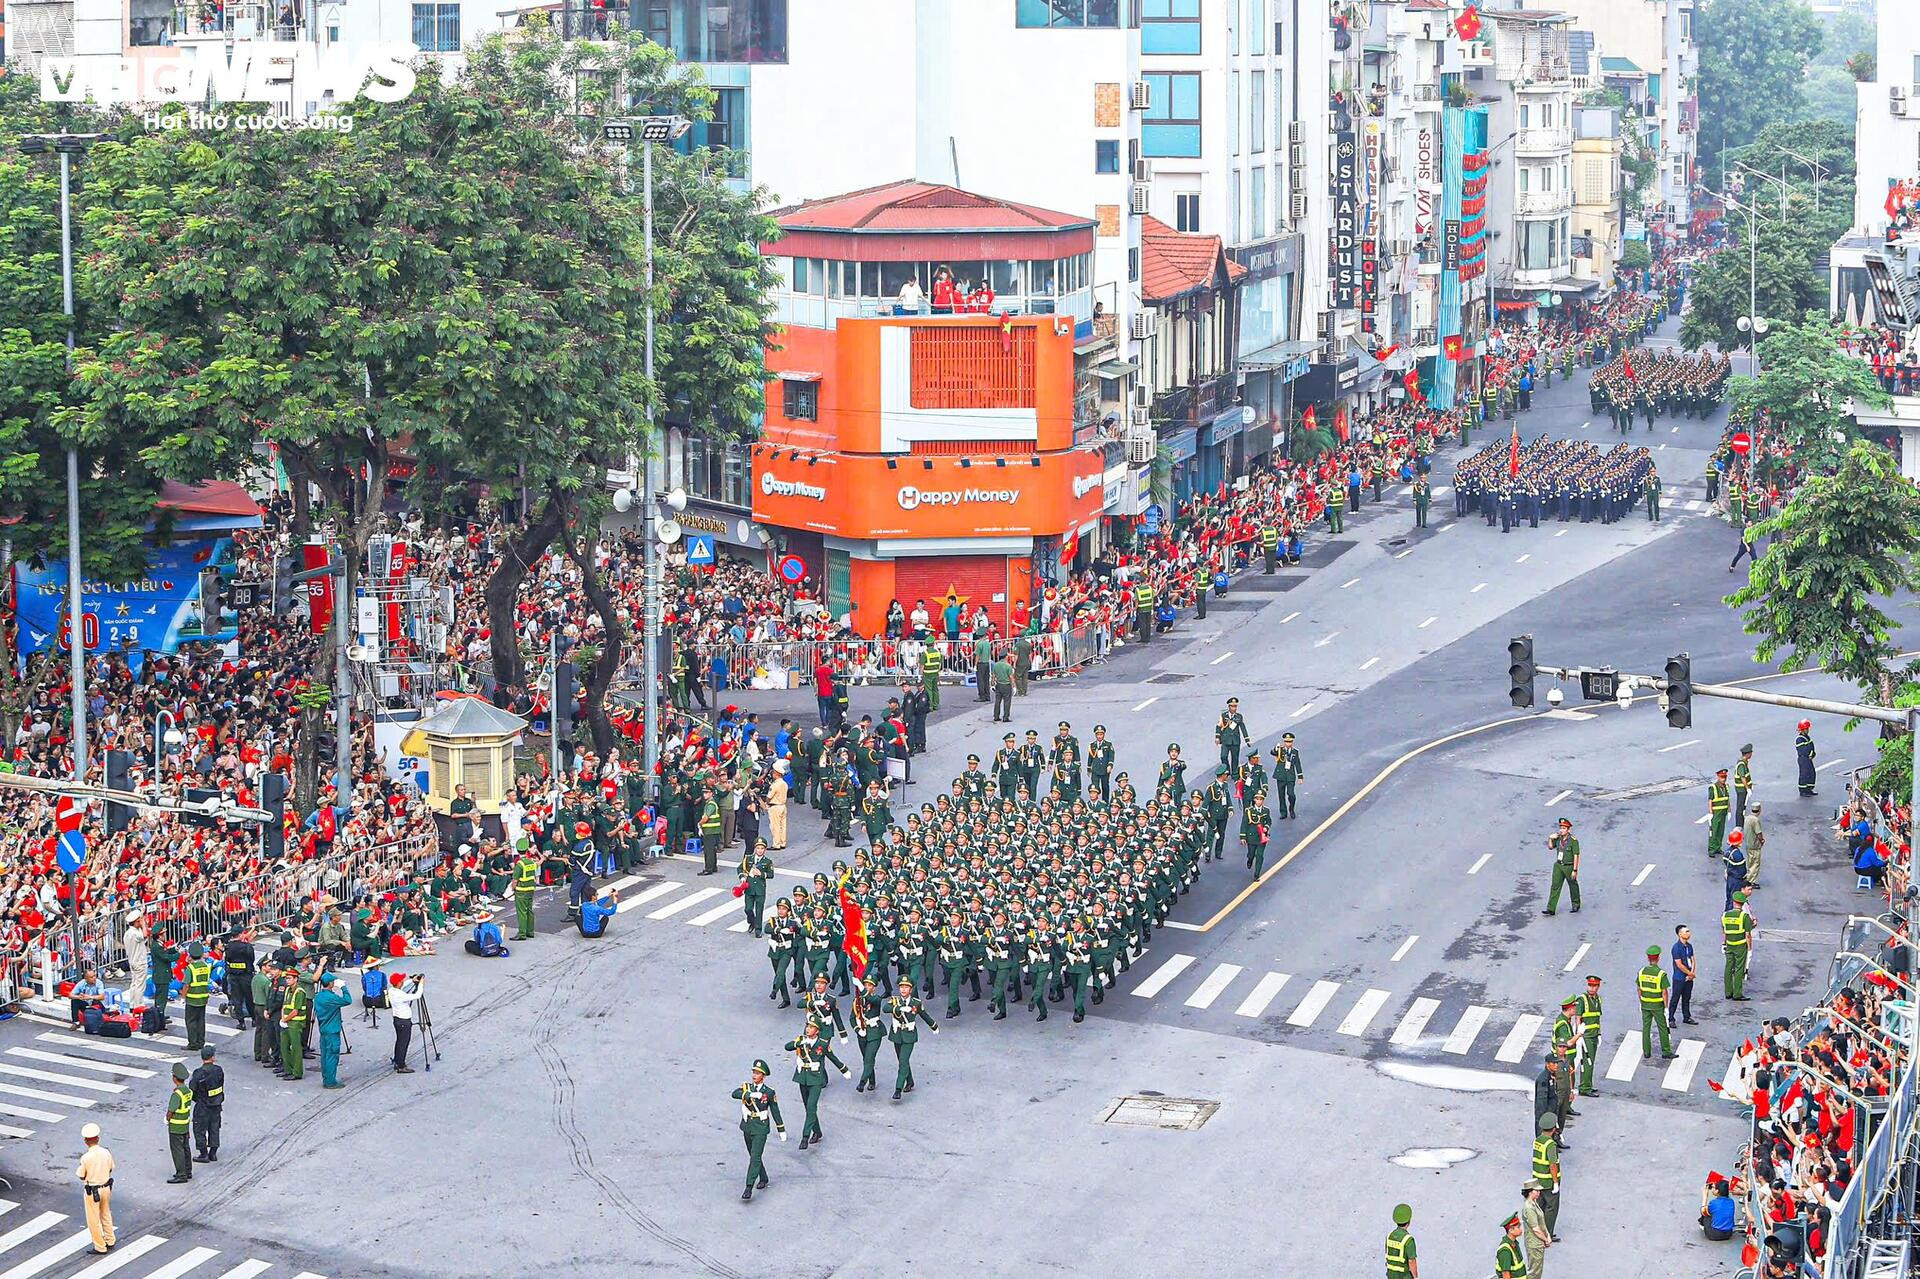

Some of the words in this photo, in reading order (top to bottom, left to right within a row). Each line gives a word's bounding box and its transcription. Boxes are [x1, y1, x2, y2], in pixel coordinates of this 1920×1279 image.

[1418, 132, 1431, 179] SHOES
[1338, 164, 1353, 300] STARDUST
[1447, 225, 1457, 270] HOTEL
[761, 471, 796, 496] Happy
[795, 481, 826, 502] Money
[897, 486, 962, 510] Happy
[964, 488, 1020, 505] Money
[391, 557, 403, 570] 5G
[59, 578, 102, 594] QỐC
[309, 584, 324, 596] 5G
[397, 757, 419, 770] 5G
